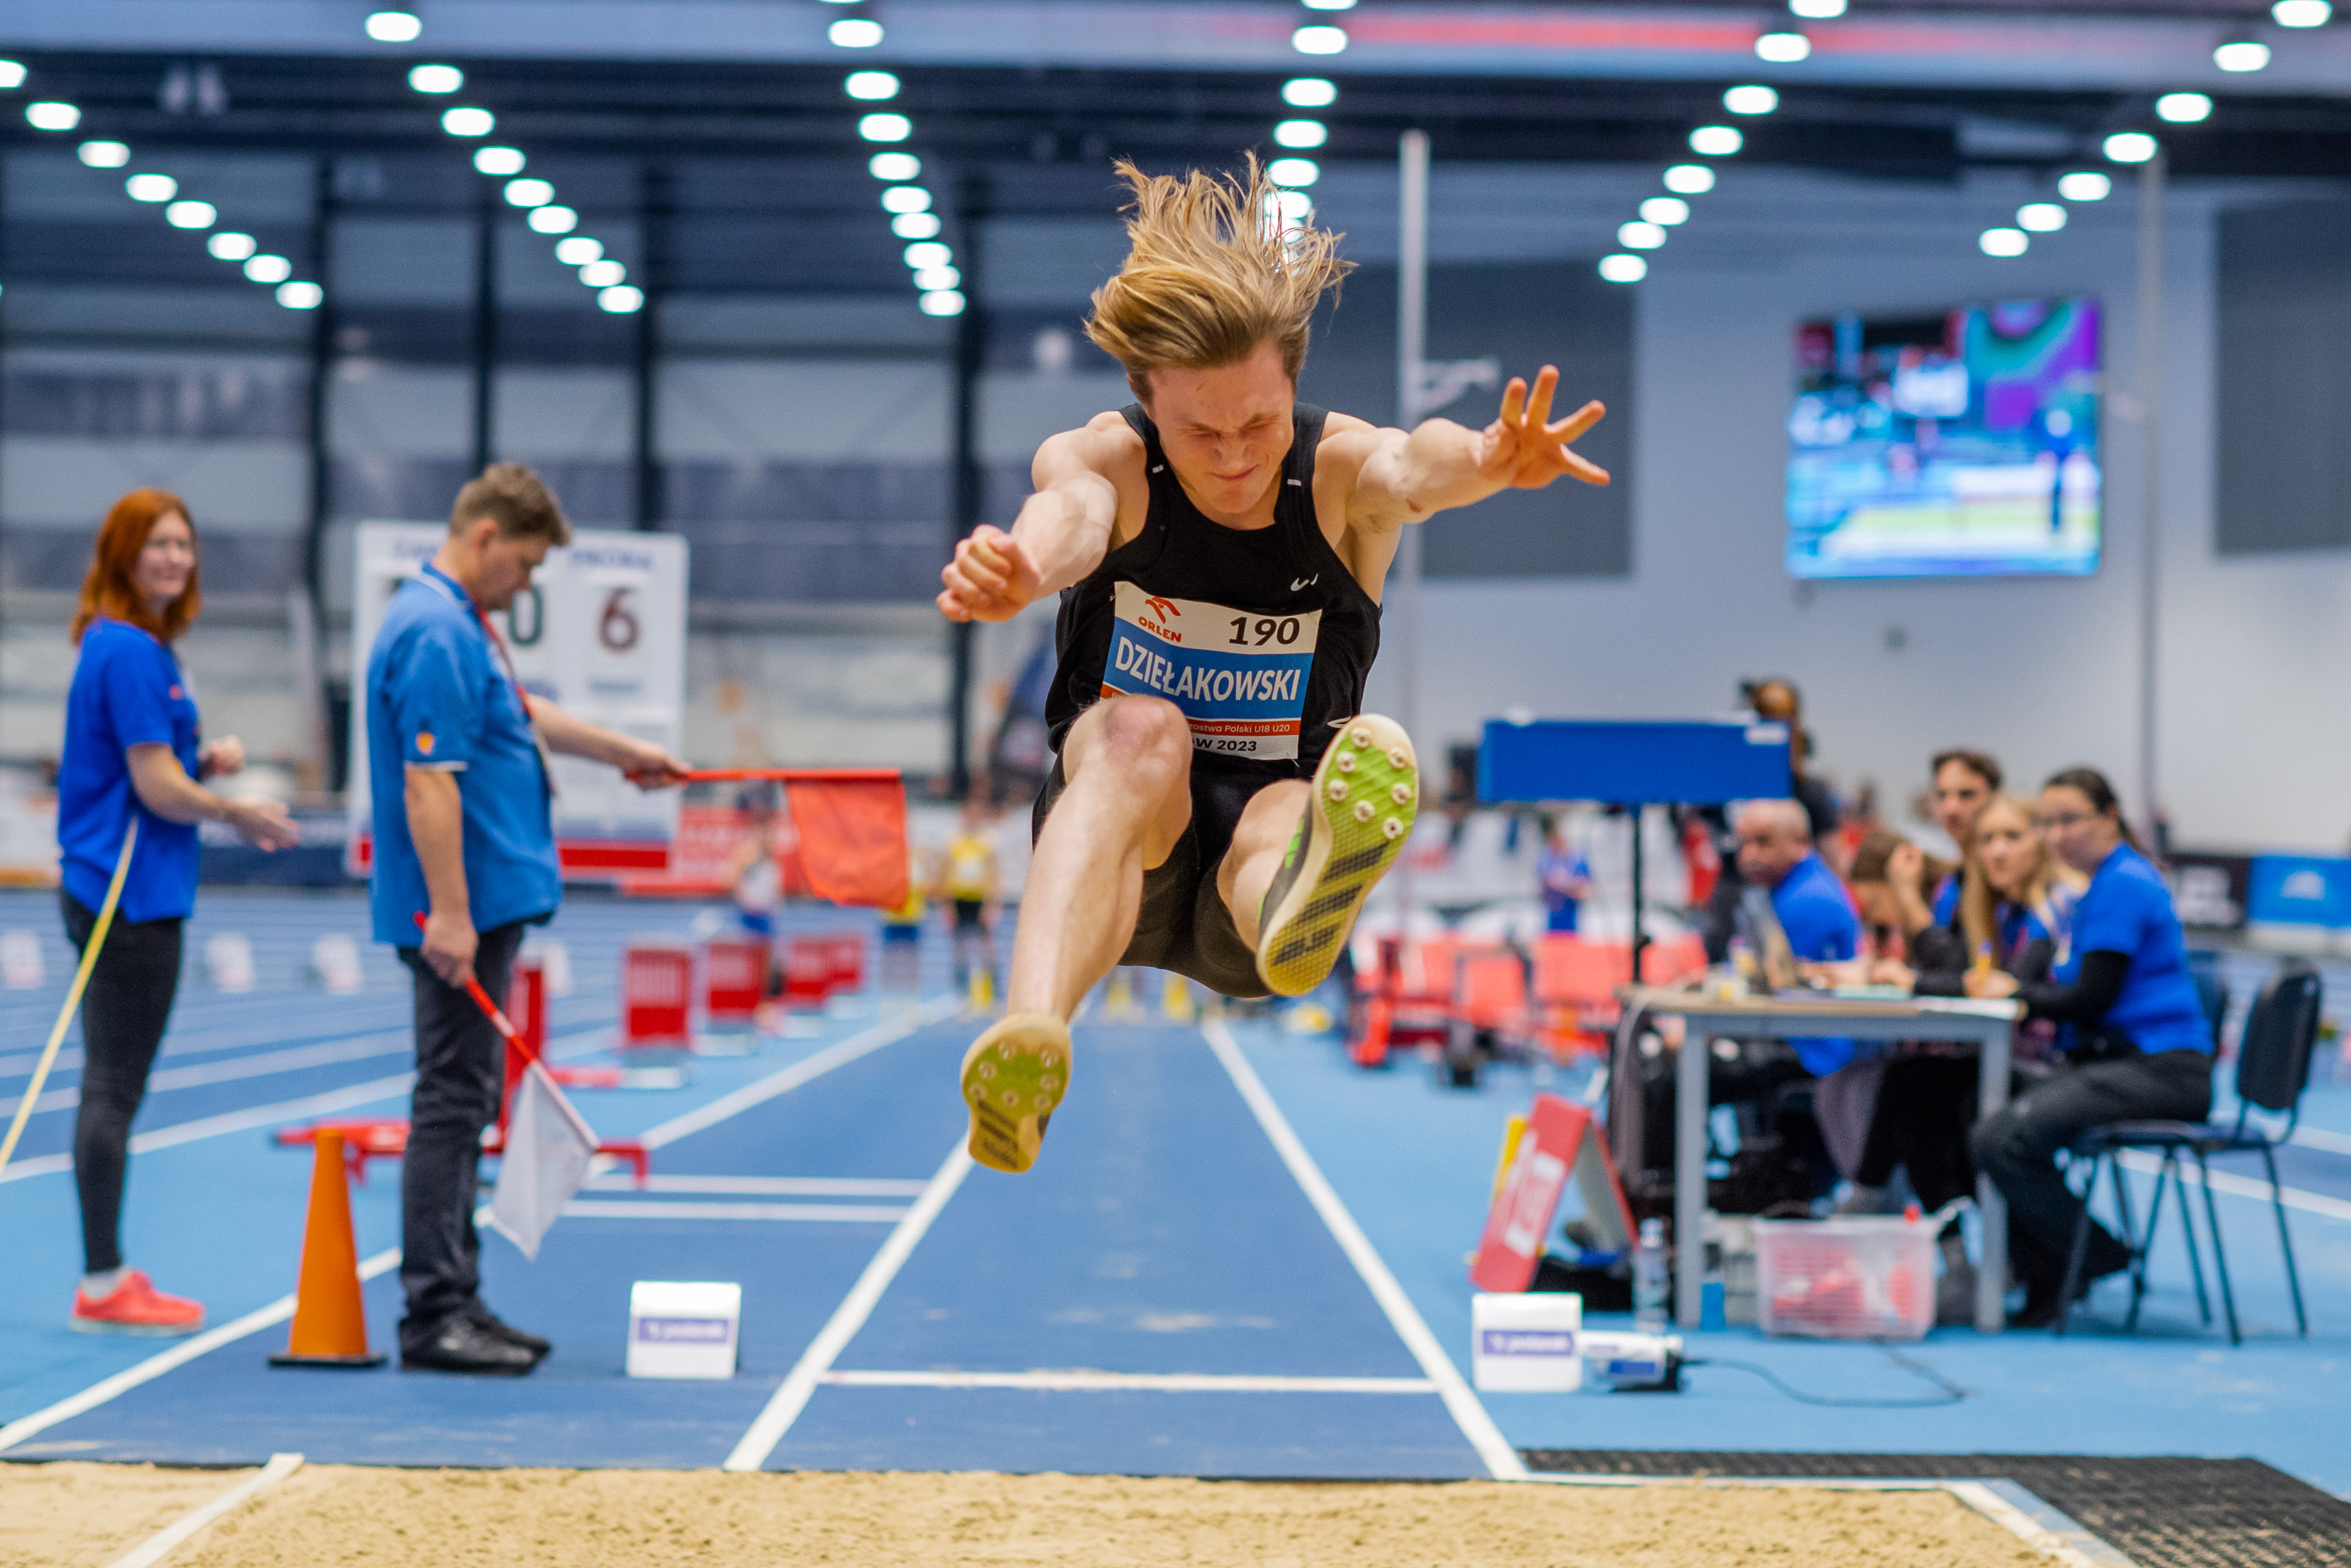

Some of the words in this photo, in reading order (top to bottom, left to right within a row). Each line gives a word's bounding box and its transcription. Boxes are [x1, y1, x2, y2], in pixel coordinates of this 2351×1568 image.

[598, 585, 640, 655] 6
[1139, 616, 1182, 643] ORLEN
[1229, 616, 1300, 646] 190
[1115, 636, 1301, 701] DZIEŁAKOWSKI
[1189, 724, 1223, 733] zostwa
[1272, 724, 1291, 733] U20
[1216, 740, 1257, 751] 2023
